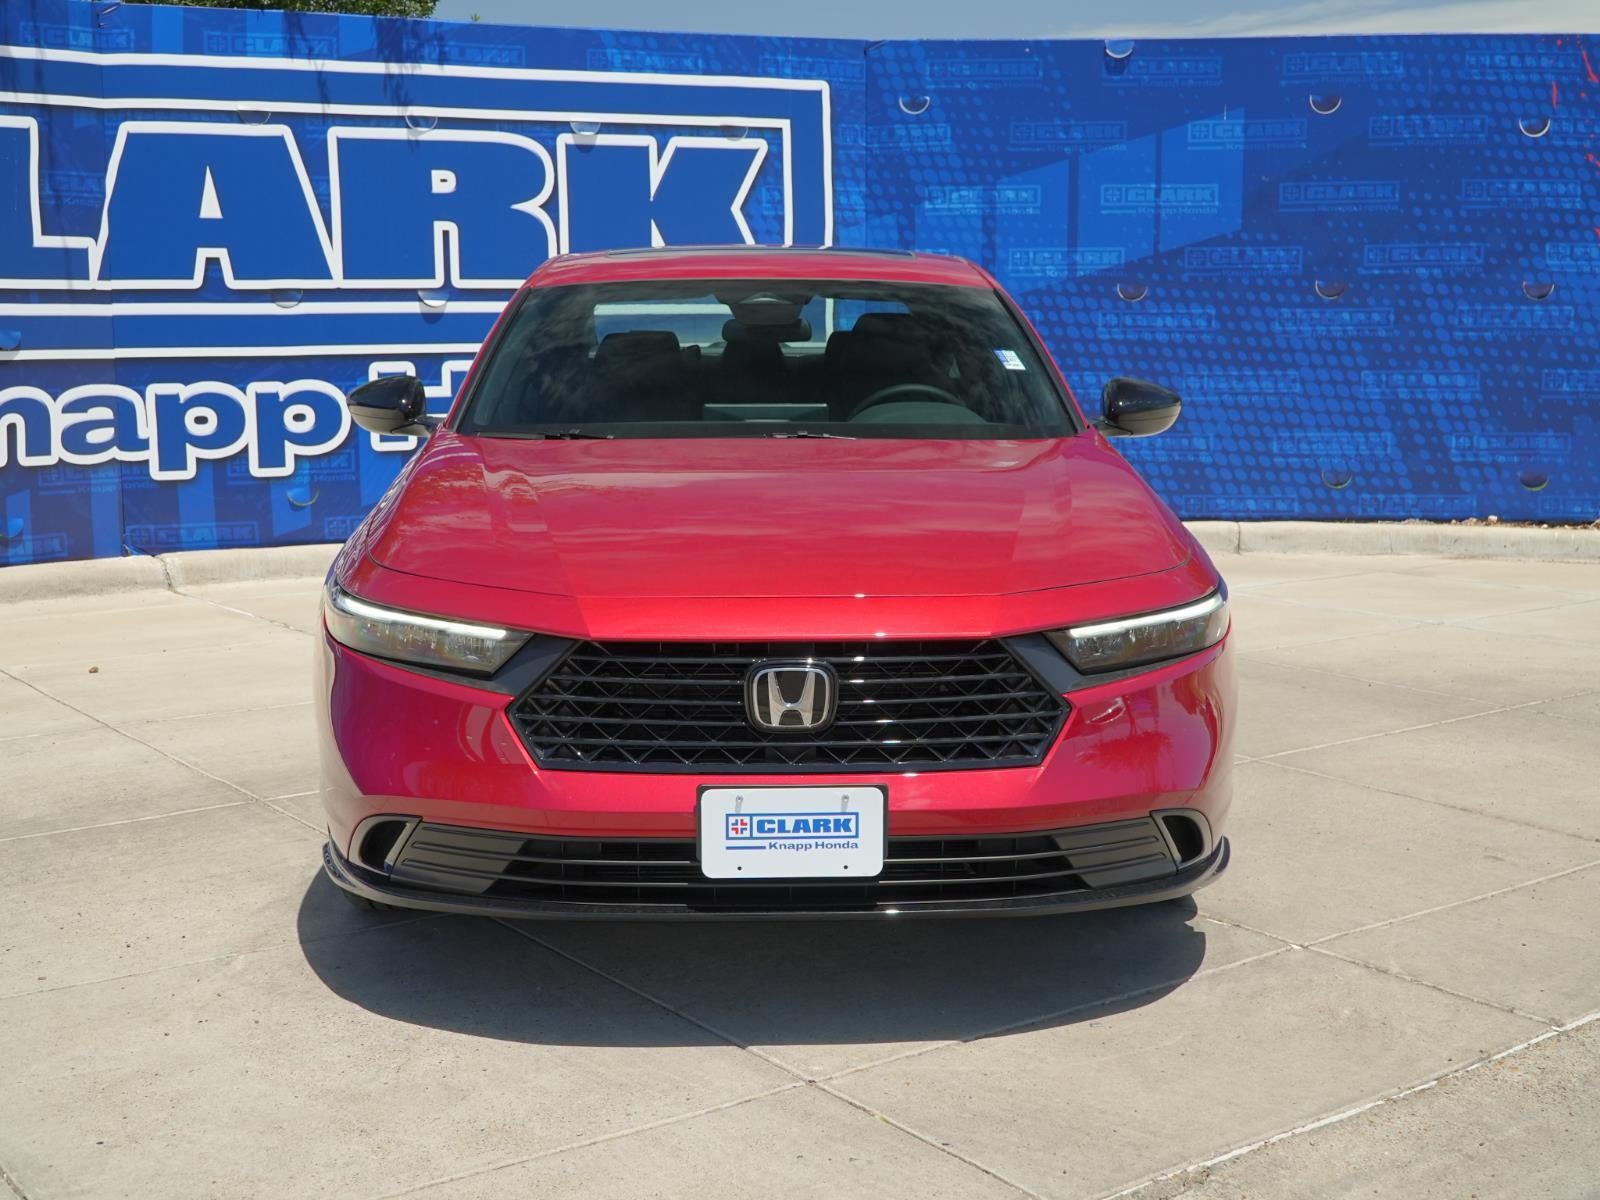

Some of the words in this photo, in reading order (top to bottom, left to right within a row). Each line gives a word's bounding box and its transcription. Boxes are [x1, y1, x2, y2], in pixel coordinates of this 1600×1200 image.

[1215, 123, 1302, 137] CLARK
[1128, 188, 1213, 202] CLARK
[756, 817, 853, 834] CLARK
[769, 841, 813, 852] Knapp
[815, 840, 859, 850] Honda
